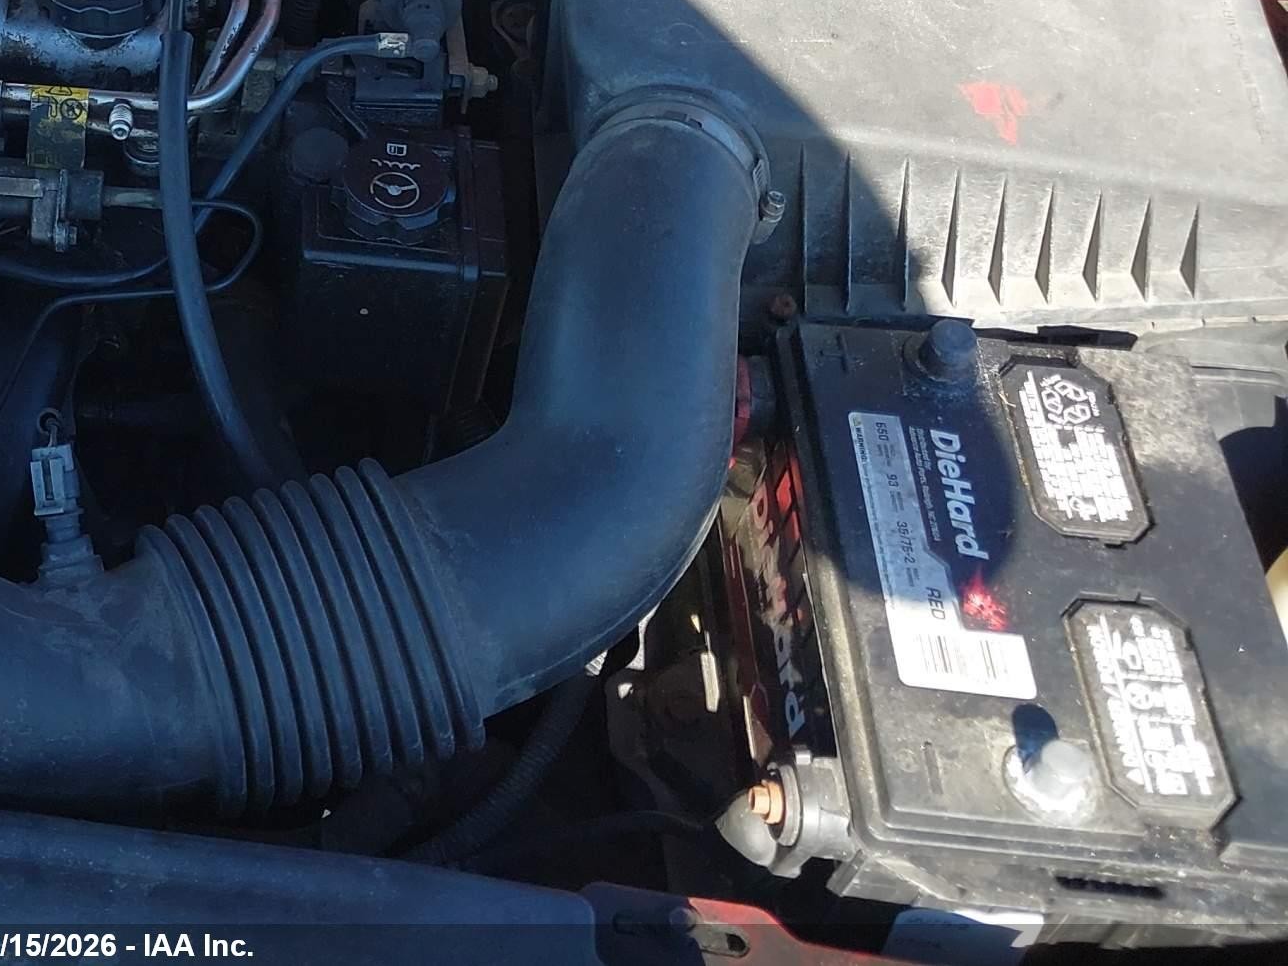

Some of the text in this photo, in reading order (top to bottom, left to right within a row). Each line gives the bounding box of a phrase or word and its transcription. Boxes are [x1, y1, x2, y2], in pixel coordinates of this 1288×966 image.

[875, 421, 889, 441] 650
[886, 473, 899, 487] 93
[929, 429, 991, 561] DieHard
[925, 587, 946, 620] RED
